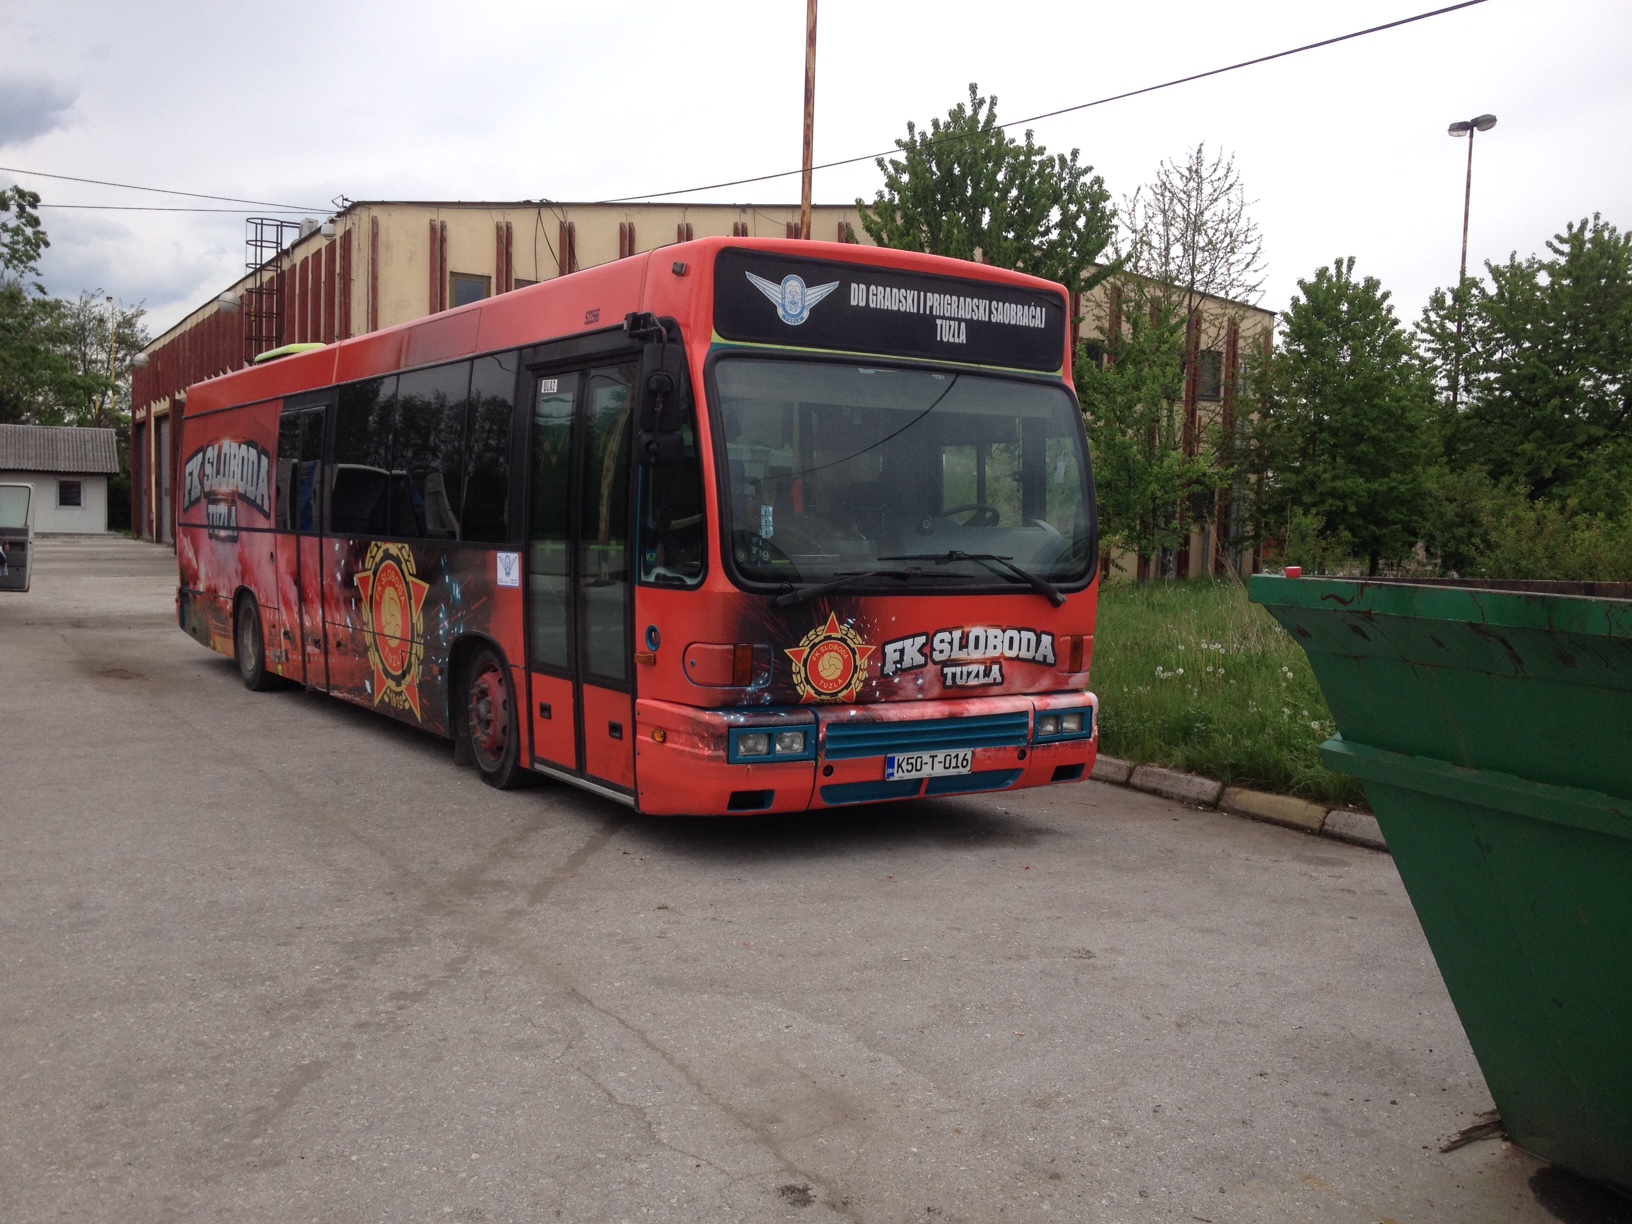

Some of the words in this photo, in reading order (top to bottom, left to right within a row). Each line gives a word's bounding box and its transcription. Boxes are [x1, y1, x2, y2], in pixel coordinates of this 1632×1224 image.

[850, 283, 867, 307] DD
[869, 285, 918, 313] GRADSKI
[920, 291, 924, 314] I
[926, 292, 989, 321] PRIGRADSKI
[991, 301, 1046, 328] SAOBRAĆAJ
[936, 318, 966, 344] TUZLA
[184, 451, 203, 509] FK
[204, 440, 270, 513] SLOBODA
[208, 503, 238, 536] TUZLA
[812, 652, 820, 661] FK
[820, 643, 849, 660] SLOBODA
[884, 635, 927, 675] FK
[932, 627, 1055, 664] SLOBODA
[819, 679, 843, 689] TUZLA
[943, 664, 1002, 686] TUZLA
[896, 753, 969, 774] K50-T-016
